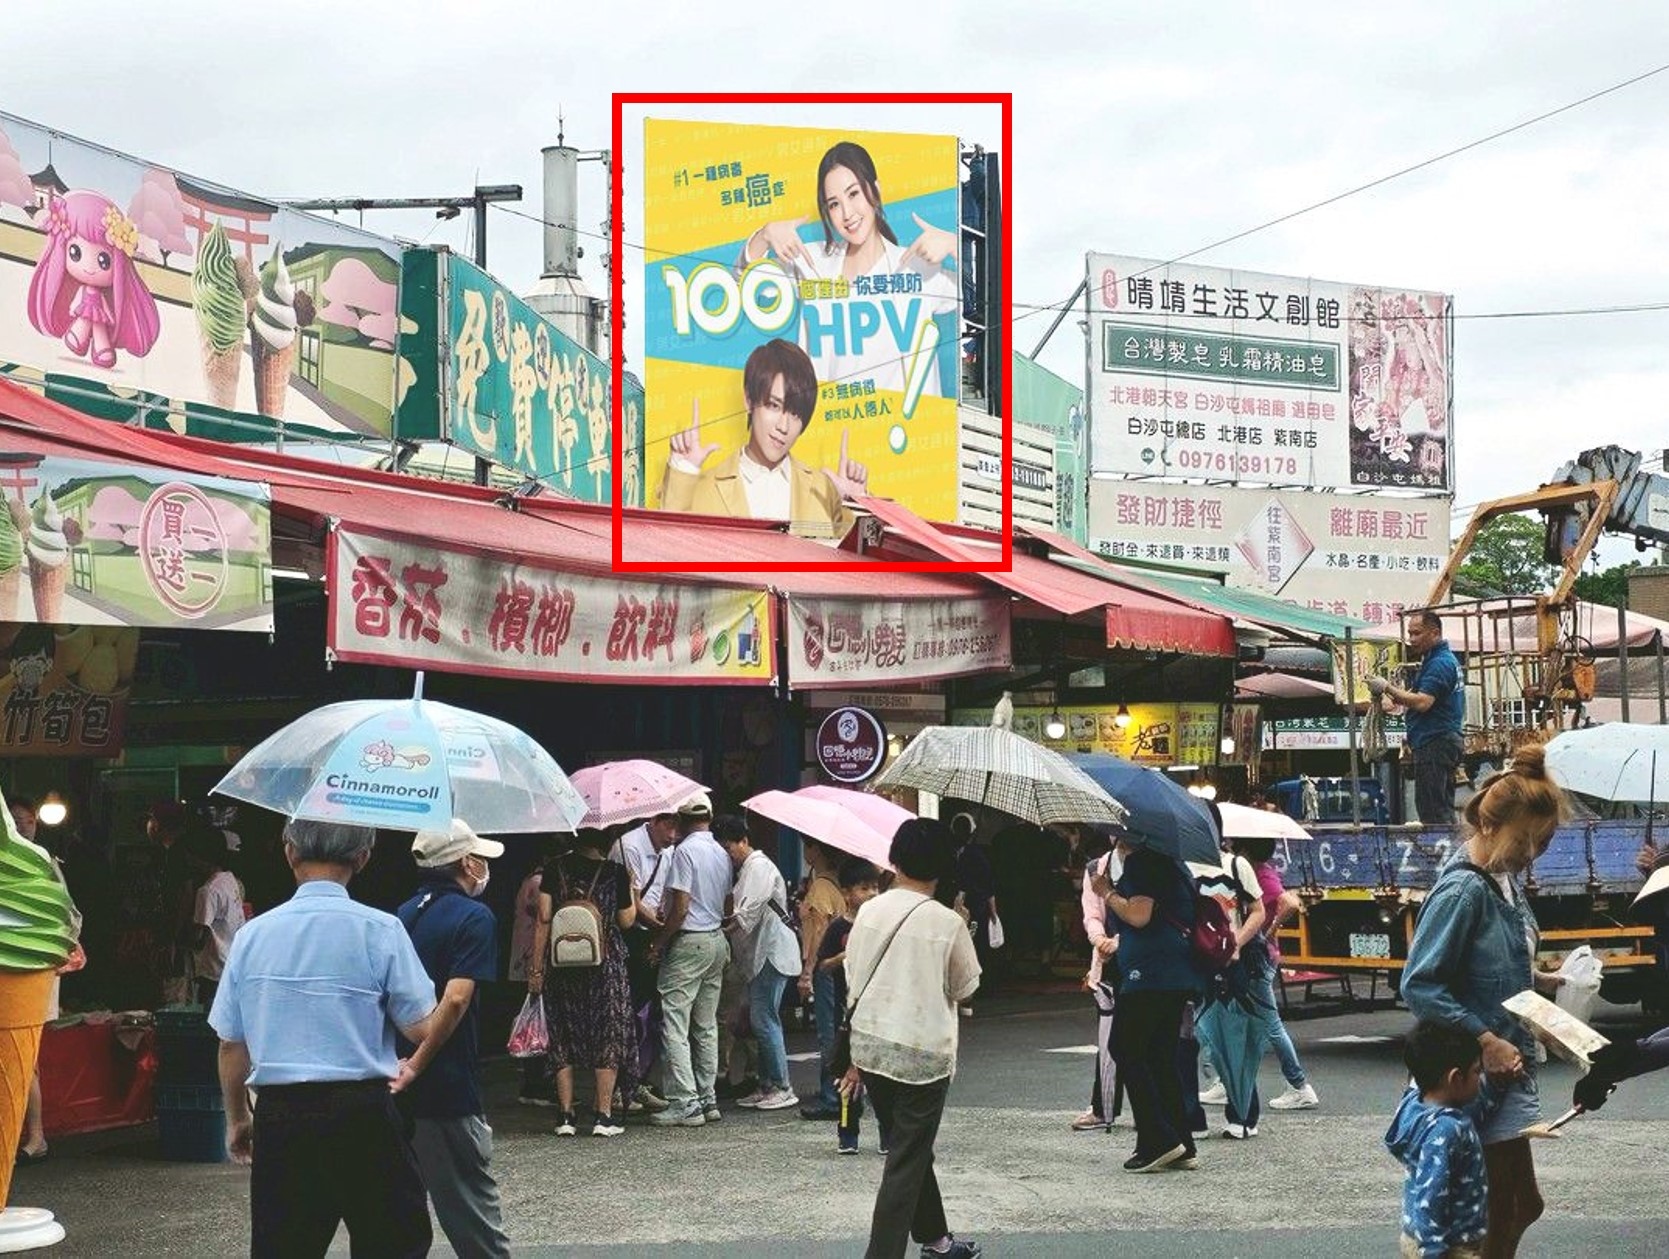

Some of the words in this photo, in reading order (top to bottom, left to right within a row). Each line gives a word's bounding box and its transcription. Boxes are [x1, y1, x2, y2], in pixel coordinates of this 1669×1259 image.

[662, 258, 798, 338] 100
[1127, 275, 1341, 329] 晴靖生活文創館
[1123, 335, 1212, 368] 台灣製皂
[1219, 346, 1328, 379] 乳霜精油皂
[1109, 385, 1189, 410] 北港朝天宮
[1127, 416, 1206, 441] 白沙屯總店
[1217, 424, 1263, 446] 北港店
[1273, 428, 1318, 449] 紫南店
[1179, 449, 1298, 475] 0976139178
[1115, 492, 1224, 531] 發財捷徑
[1329, 506, 1429, 541] 離廟最近
[1266, 505, 1282, 583] 往紫南宮
[326, 773, 440, 800] Cinnamoroll
